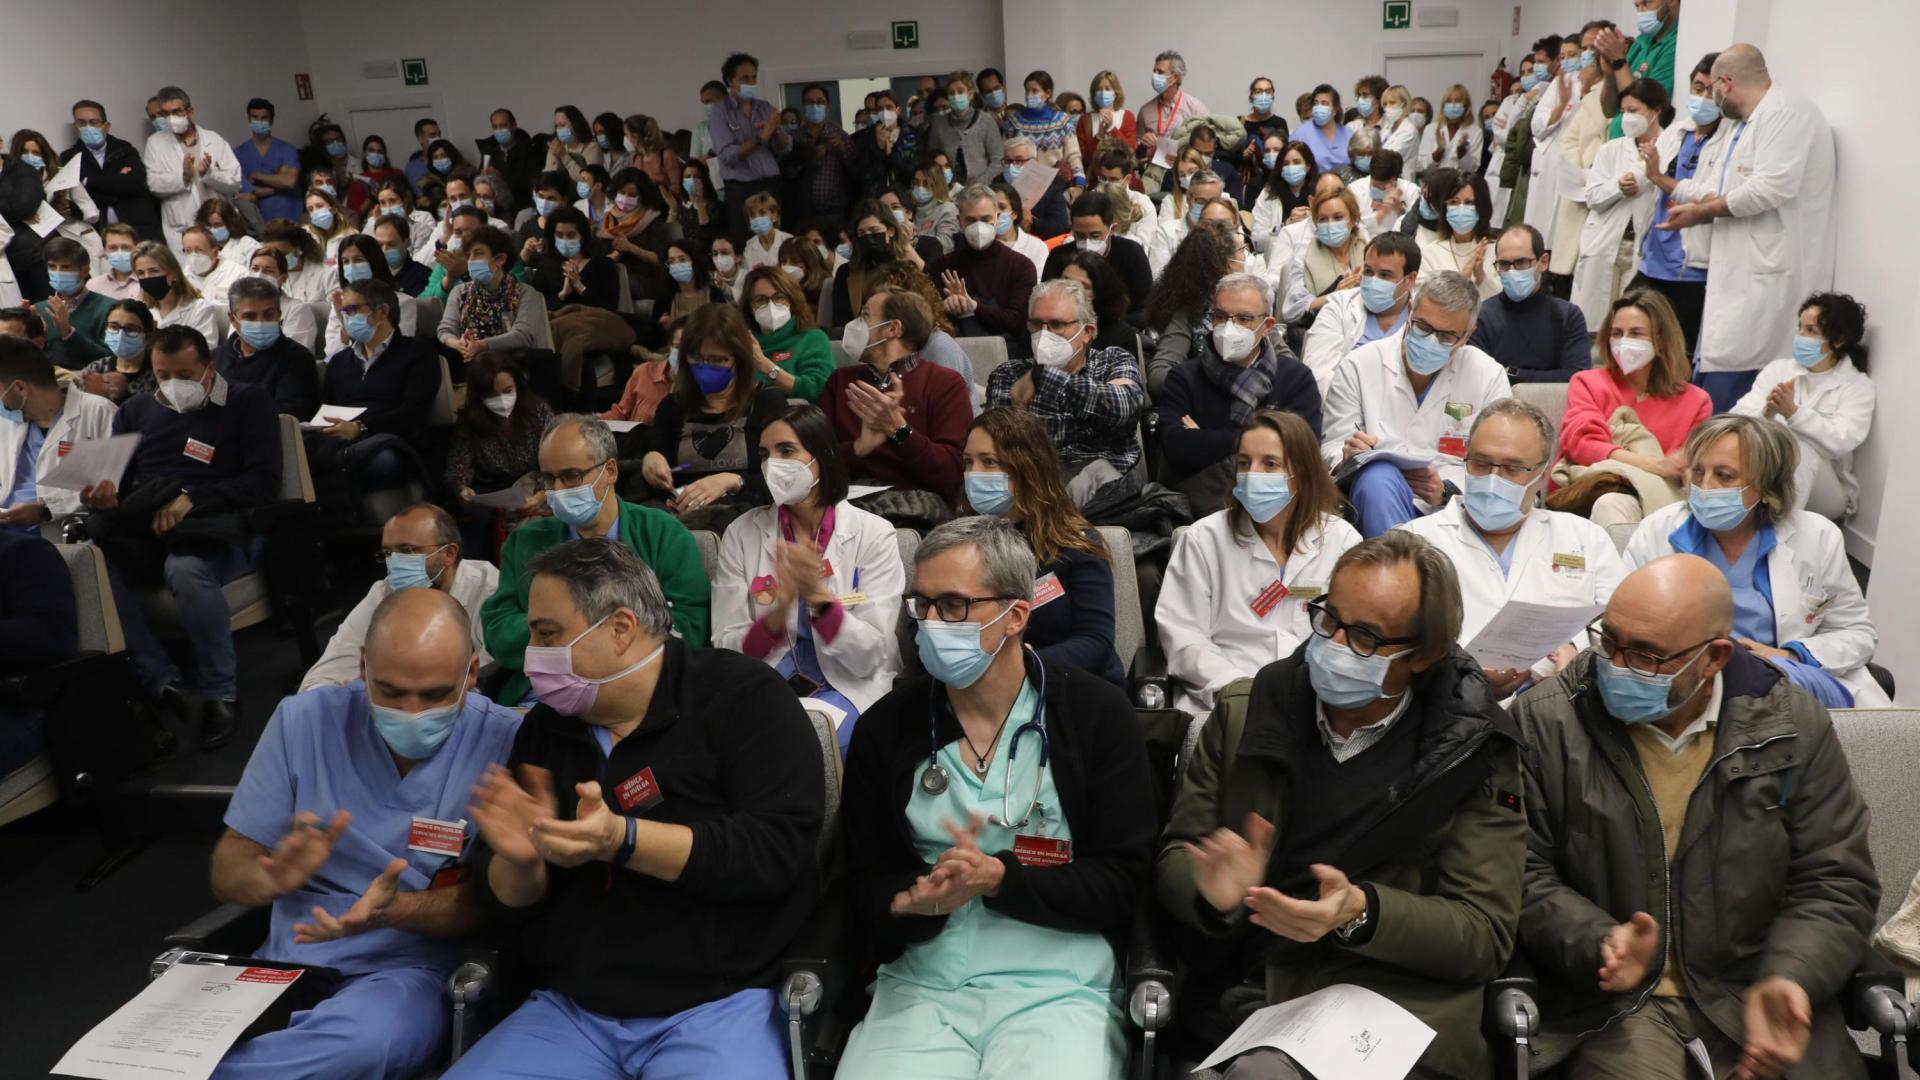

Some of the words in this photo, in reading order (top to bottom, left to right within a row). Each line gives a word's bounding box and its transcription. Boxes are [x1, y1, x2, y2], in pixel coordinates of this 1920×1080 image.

[710, 457, 746, 469] LOVE
[623, 790, 631, 800] EN
[630, 780, 649, 796] HUELGA
